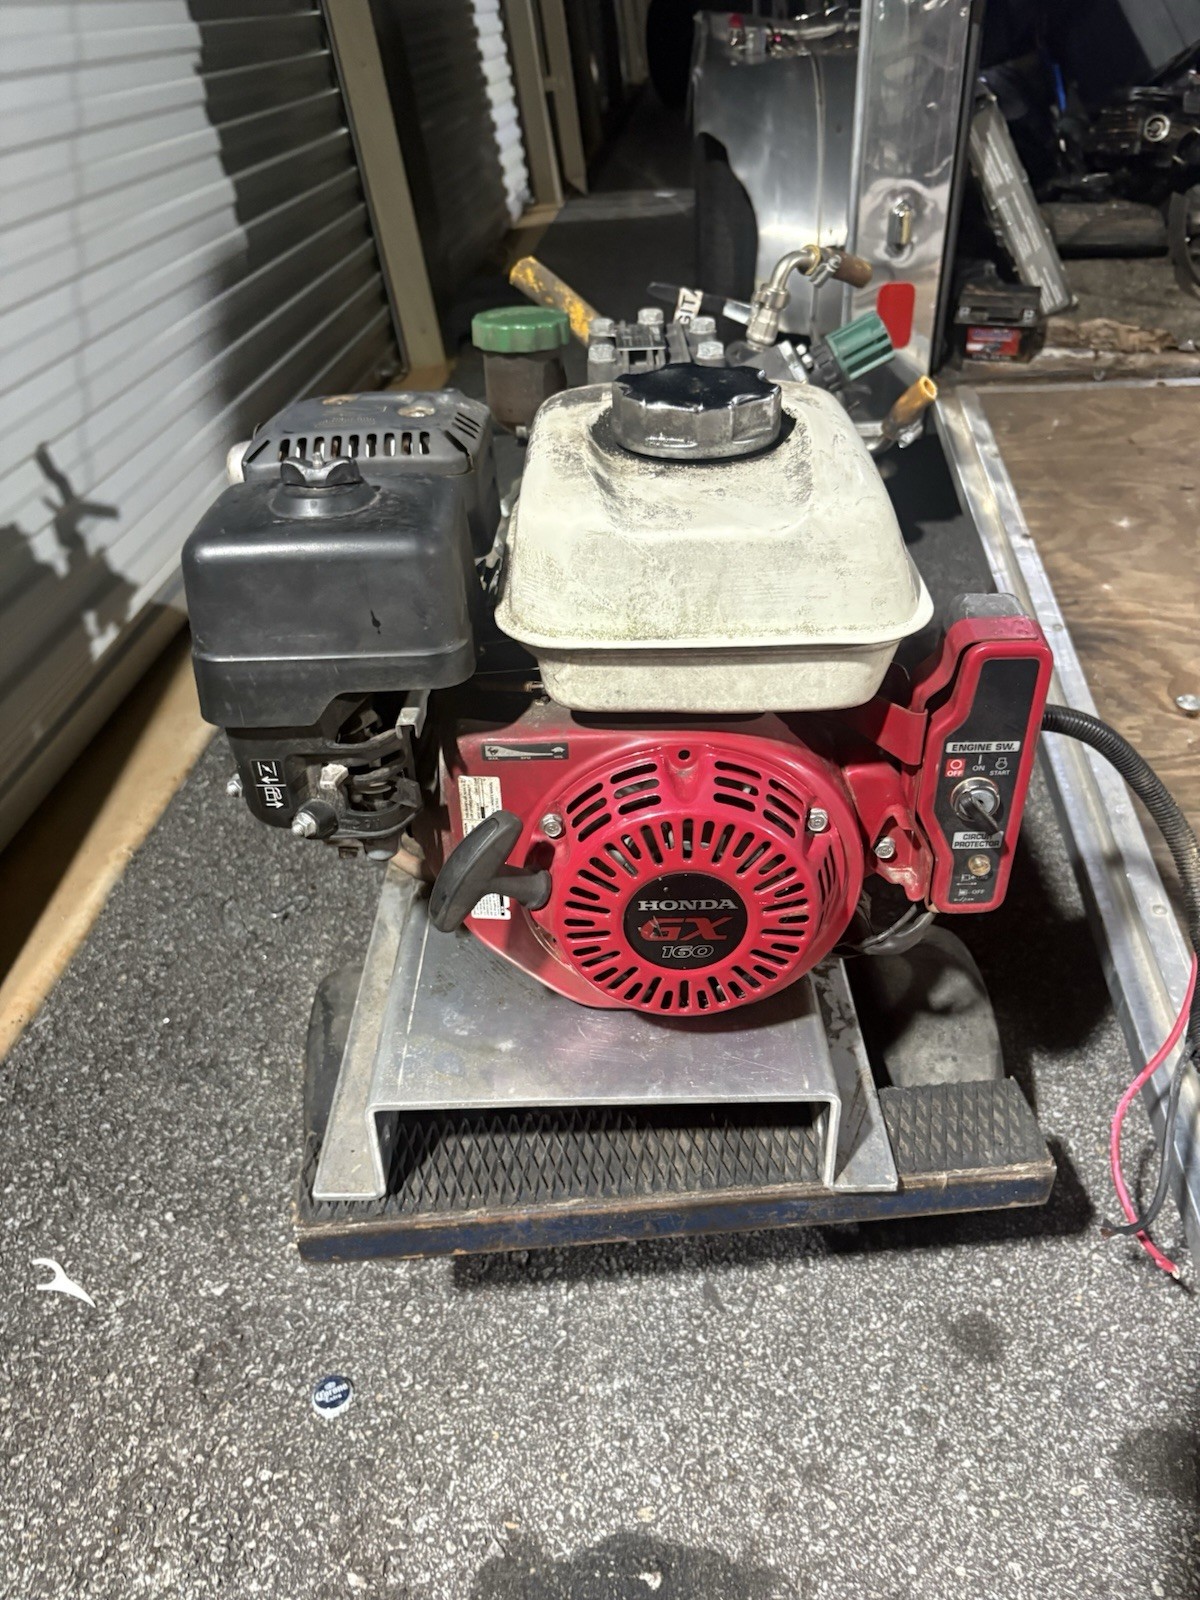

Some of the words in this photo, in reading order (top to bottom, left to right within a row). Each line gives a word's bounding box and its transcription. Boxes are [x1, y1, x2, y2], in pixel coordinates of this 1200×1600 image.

[951, 743, 992, 752] ENGINE
[995, 742, 1015, 751] SW.
[954, 840, 1000, 848] PROTECTOR
[637, 899, 739, 911] HONDA
[639, 916, 734, 941] GX
[661, 945, 715, 959] 160
